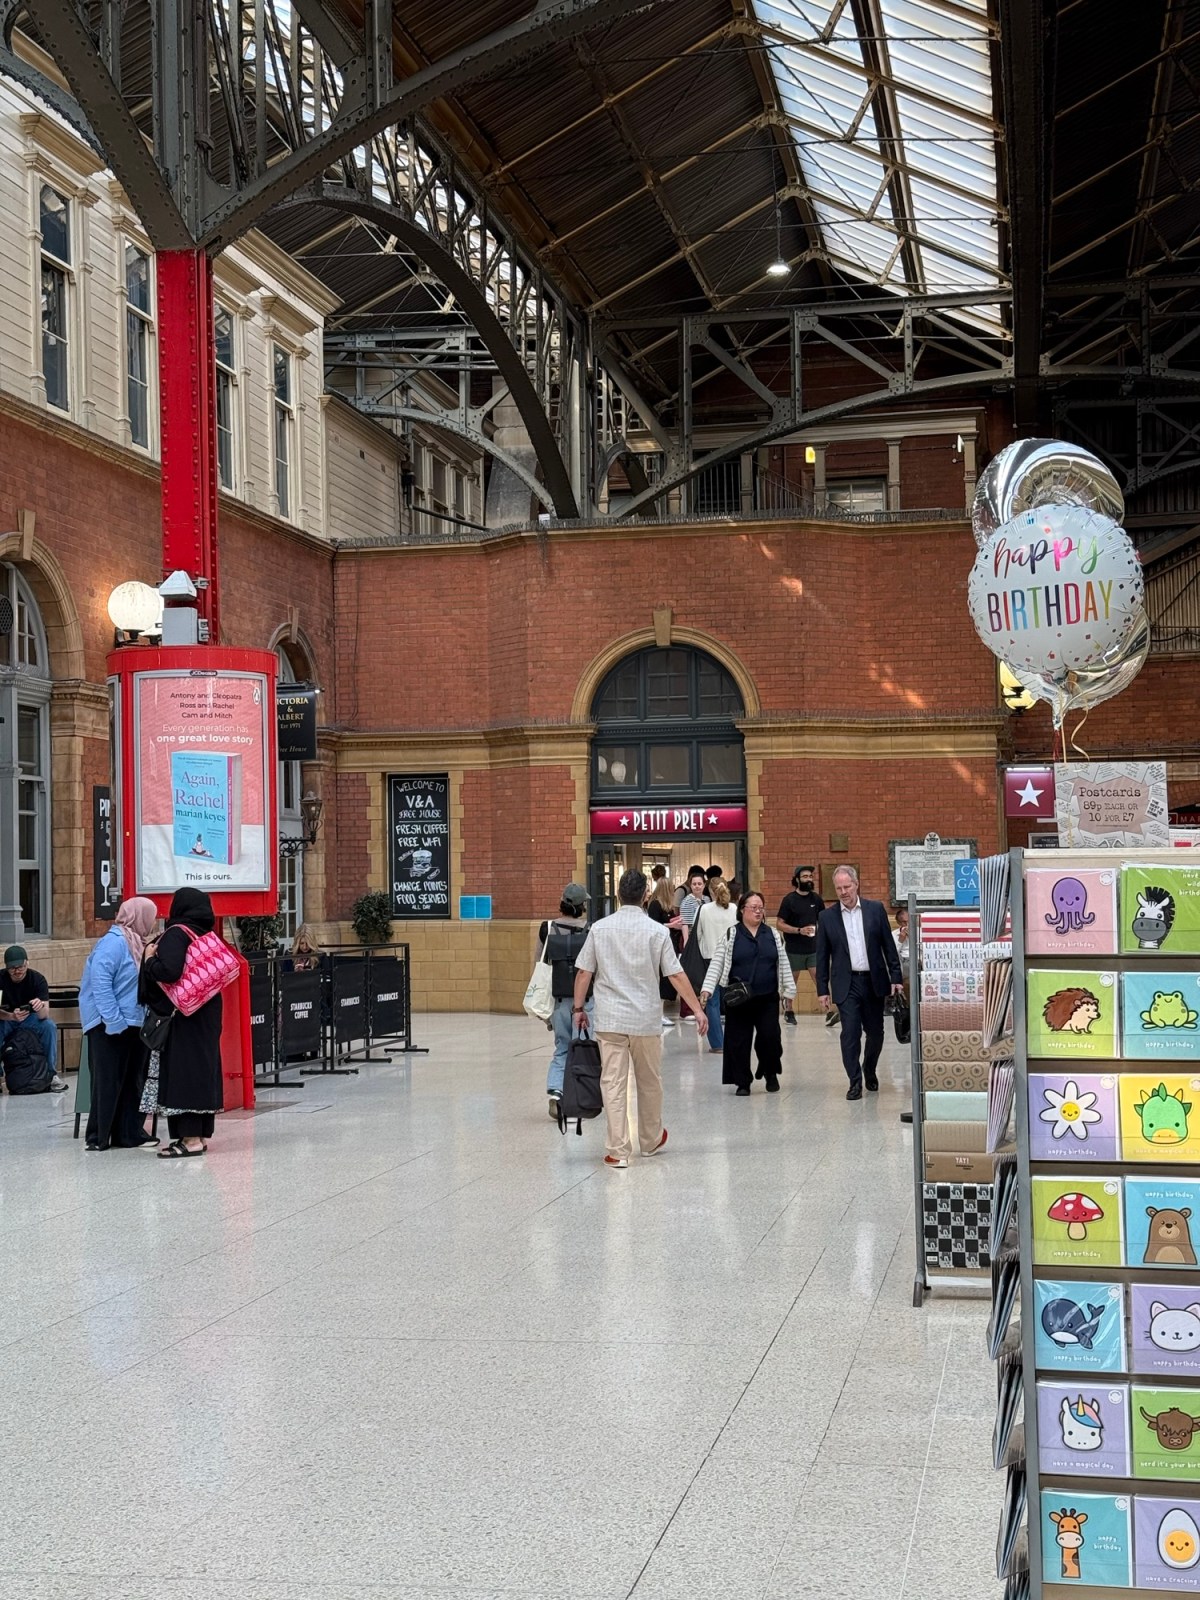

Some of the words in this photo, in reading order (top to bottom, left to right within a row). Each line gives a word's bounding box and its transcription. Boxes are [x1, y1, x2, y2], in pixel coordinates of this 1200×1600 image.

[994, 536, 1104, 579] happy
[987, 580, 1113, 632] BIRTHDAY
[170, 692, 196, 700] Antony
[277, 697, 309, 705] ICTORIA
[287, 705, 294, 713] &
[162, 724, 186, 733] Every
[188, 724, 235, 734] generation
[236, 725, 249, 733] has
[178, 735, 207, 744] great
[209, 734, 230, 743] love
[232, 736, 253, 745] story
[181, 770, 219, 789] Again,
[396, 781, 434, 793] WELCOME
[435, 782, 445, 793] TO
[1079, 786, 1141, 798] Postcards
[175, 788, 224, 810] Rachel
[405, 794, 435, 809] V&A
[99, 798, 110, 817] PI
[1083, 800, 1102, 812] 89p
[1104, 802, 1125, 811] EACH
[1127, 802, 1139, 811] OR
[175, 809, 203, 819] marian
[204, 810, 226, 823] keyes
[398, 810, 417, 819] FREE
[633, 810, 669, 831] PETIT
[674, 808, 706, 830] PRET
[1089, 812, 1101, 822] 10
[1104, 814, 1120, 822] FOR
[1122, 812, 1135, 822] £7
[395, 823, 422, 835] FRESH
[423, 823, 448, 835] COFFEE
[397, 836, 420, 848] FREE
[960, 864, 979, 876] CA
[185, 872, 203, 881] This
[204, 872, 211, 880] is
[213, 873, 233, 881] ours.
[393, 880, 421, 892] CHARGE
[956, 878, 977, 889] GA
[396, 894, 416, 905] FOOD
[417, 893, 448, 905] SERVED
[340, 996, 360, 1007] STARBUCKS
[377, 991, 399, 1003] STARBUCKS
[290, 1001, 313, 1011] STARBUCKS
[294, 1010, 309, 1019] COFFEE
